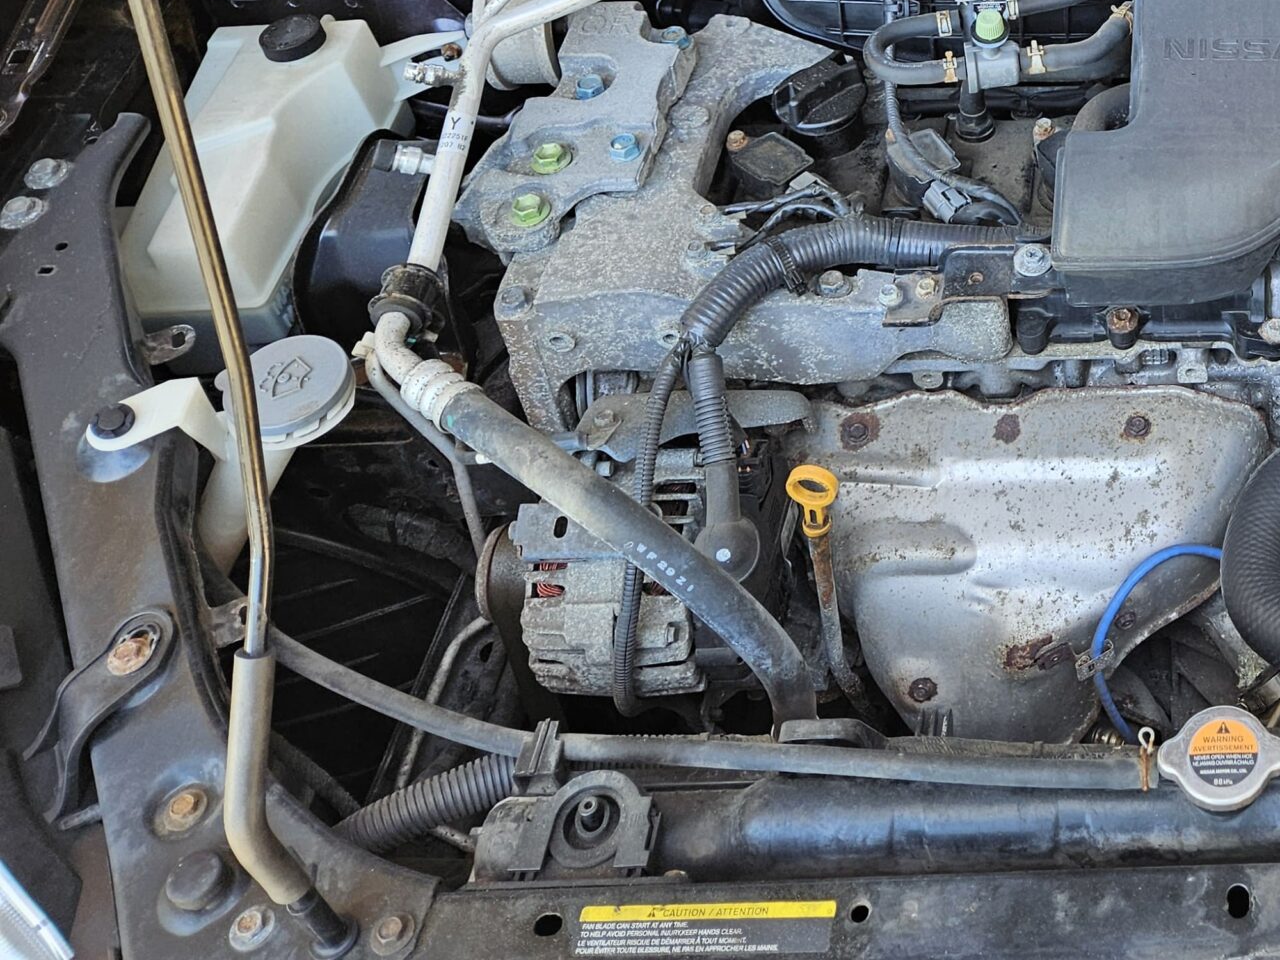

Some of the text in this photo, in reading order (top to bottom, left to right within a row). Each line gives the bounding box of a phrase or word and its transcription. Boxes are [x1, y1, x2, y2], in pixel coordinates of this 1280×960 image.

[451, 116, 462, 130] Y
[1202, 735, 1244, 744] WARNING
[1192, 744, 1254, 753] AVERTISSEMENT
[662, 908, 706, 918] CAUTION
[716, 906, 769, 916] ATTENTION
[698, 928, 720, 936] HANDS
[593, 946, 616, 954] ÉVITER
[744, 944, 757, 952] LES
